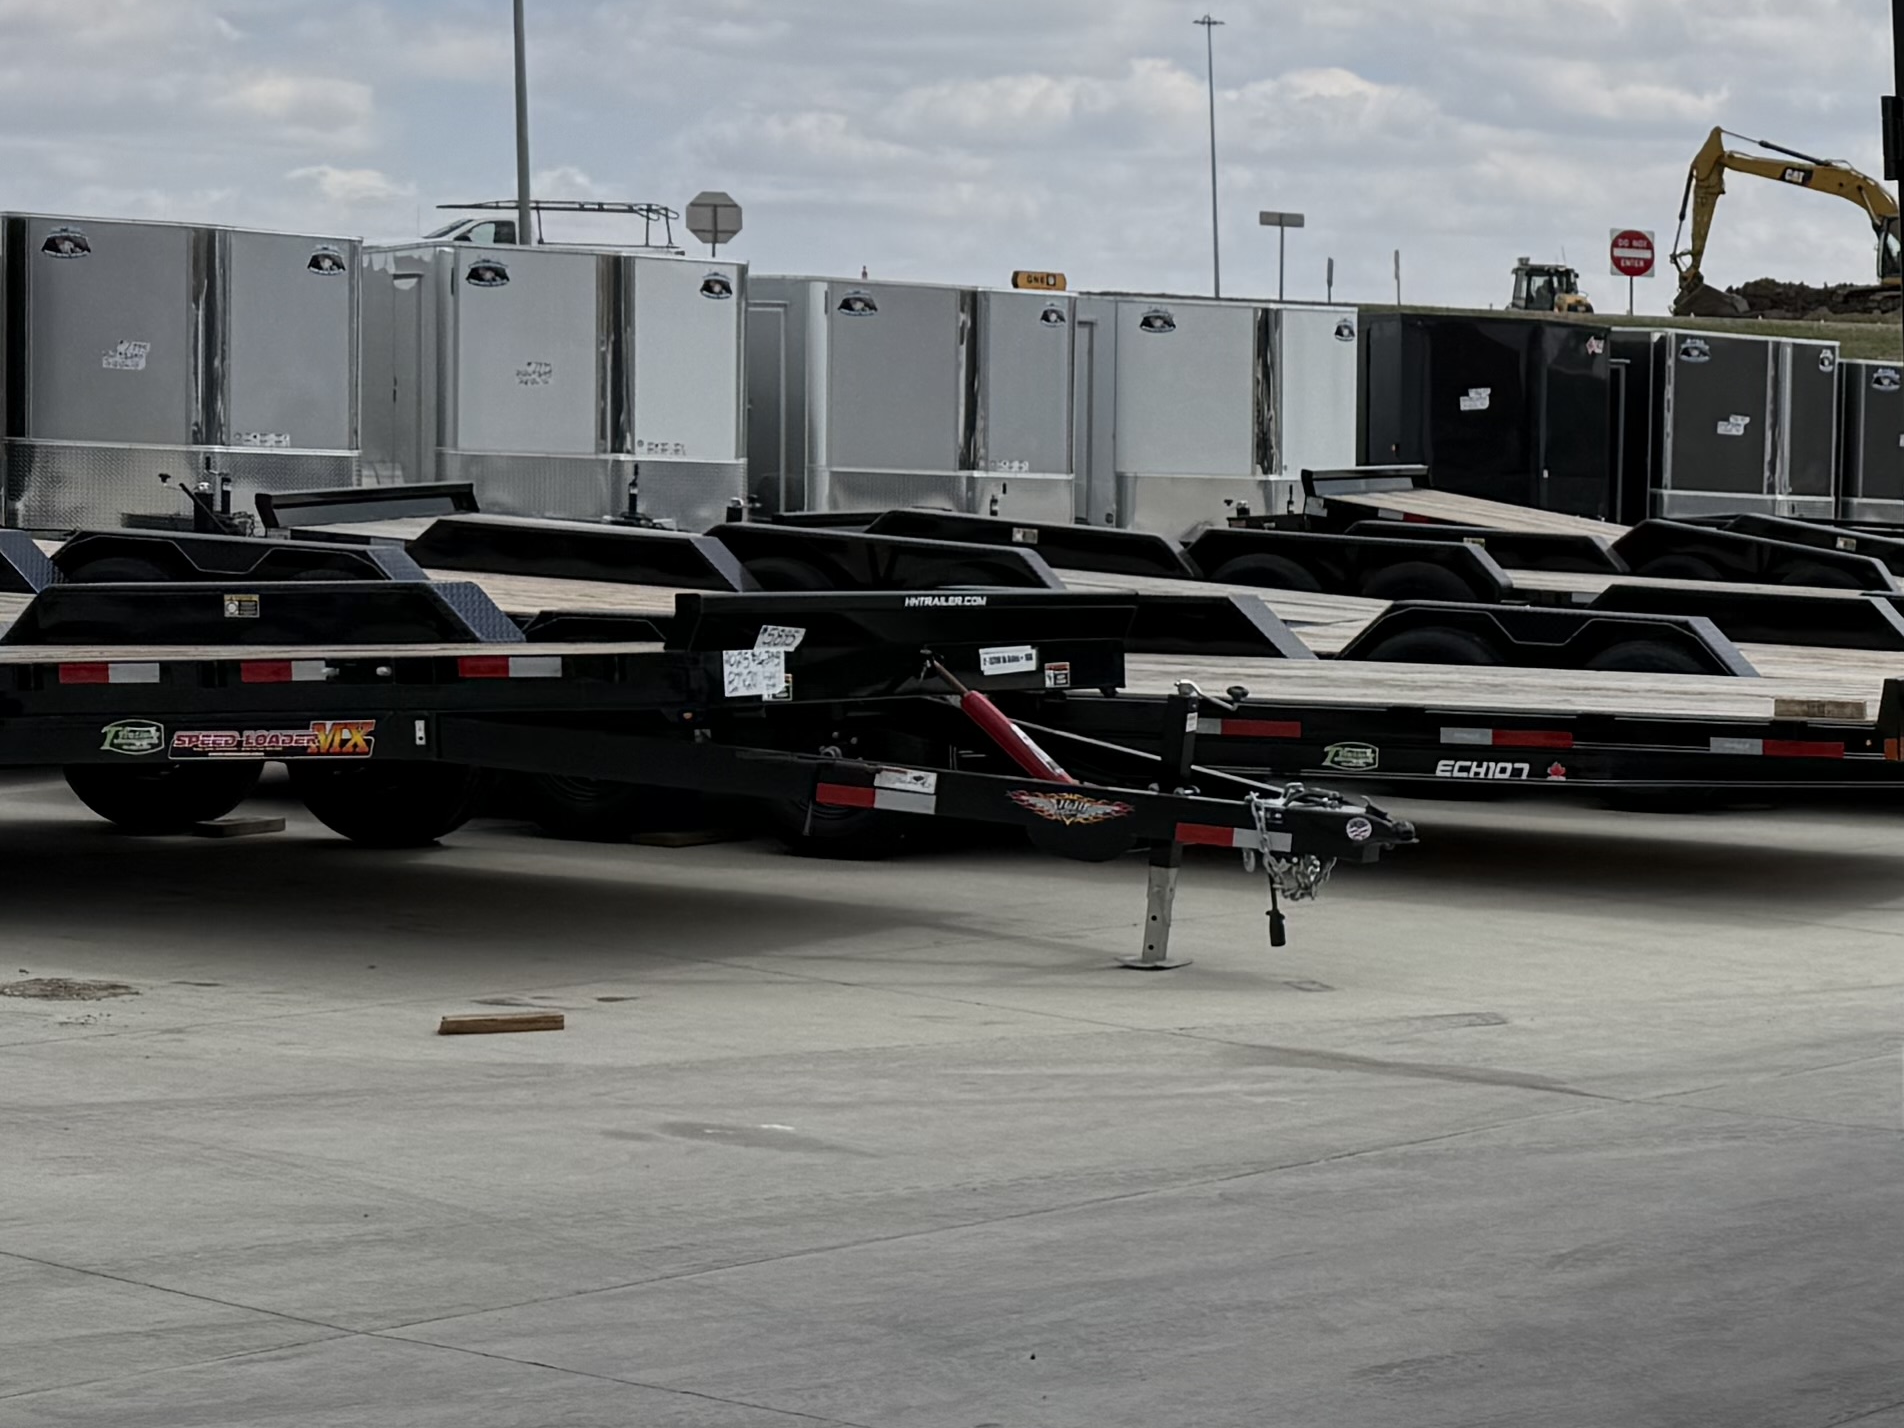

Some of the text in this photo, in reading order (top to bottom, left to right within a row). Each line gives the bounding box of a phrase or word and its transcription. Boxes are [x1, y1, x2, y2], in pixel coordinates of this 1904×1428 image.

[1785, 168, 1805, 183] CAT
[1618, 238, 1648, 248] DO NOT
[1620, 258, 1645, 268] ENTER
[172, 733, 237, 748] SPEED
[241, 732, 320, 748] LOADER
[306, 720, 376, 755] MX
